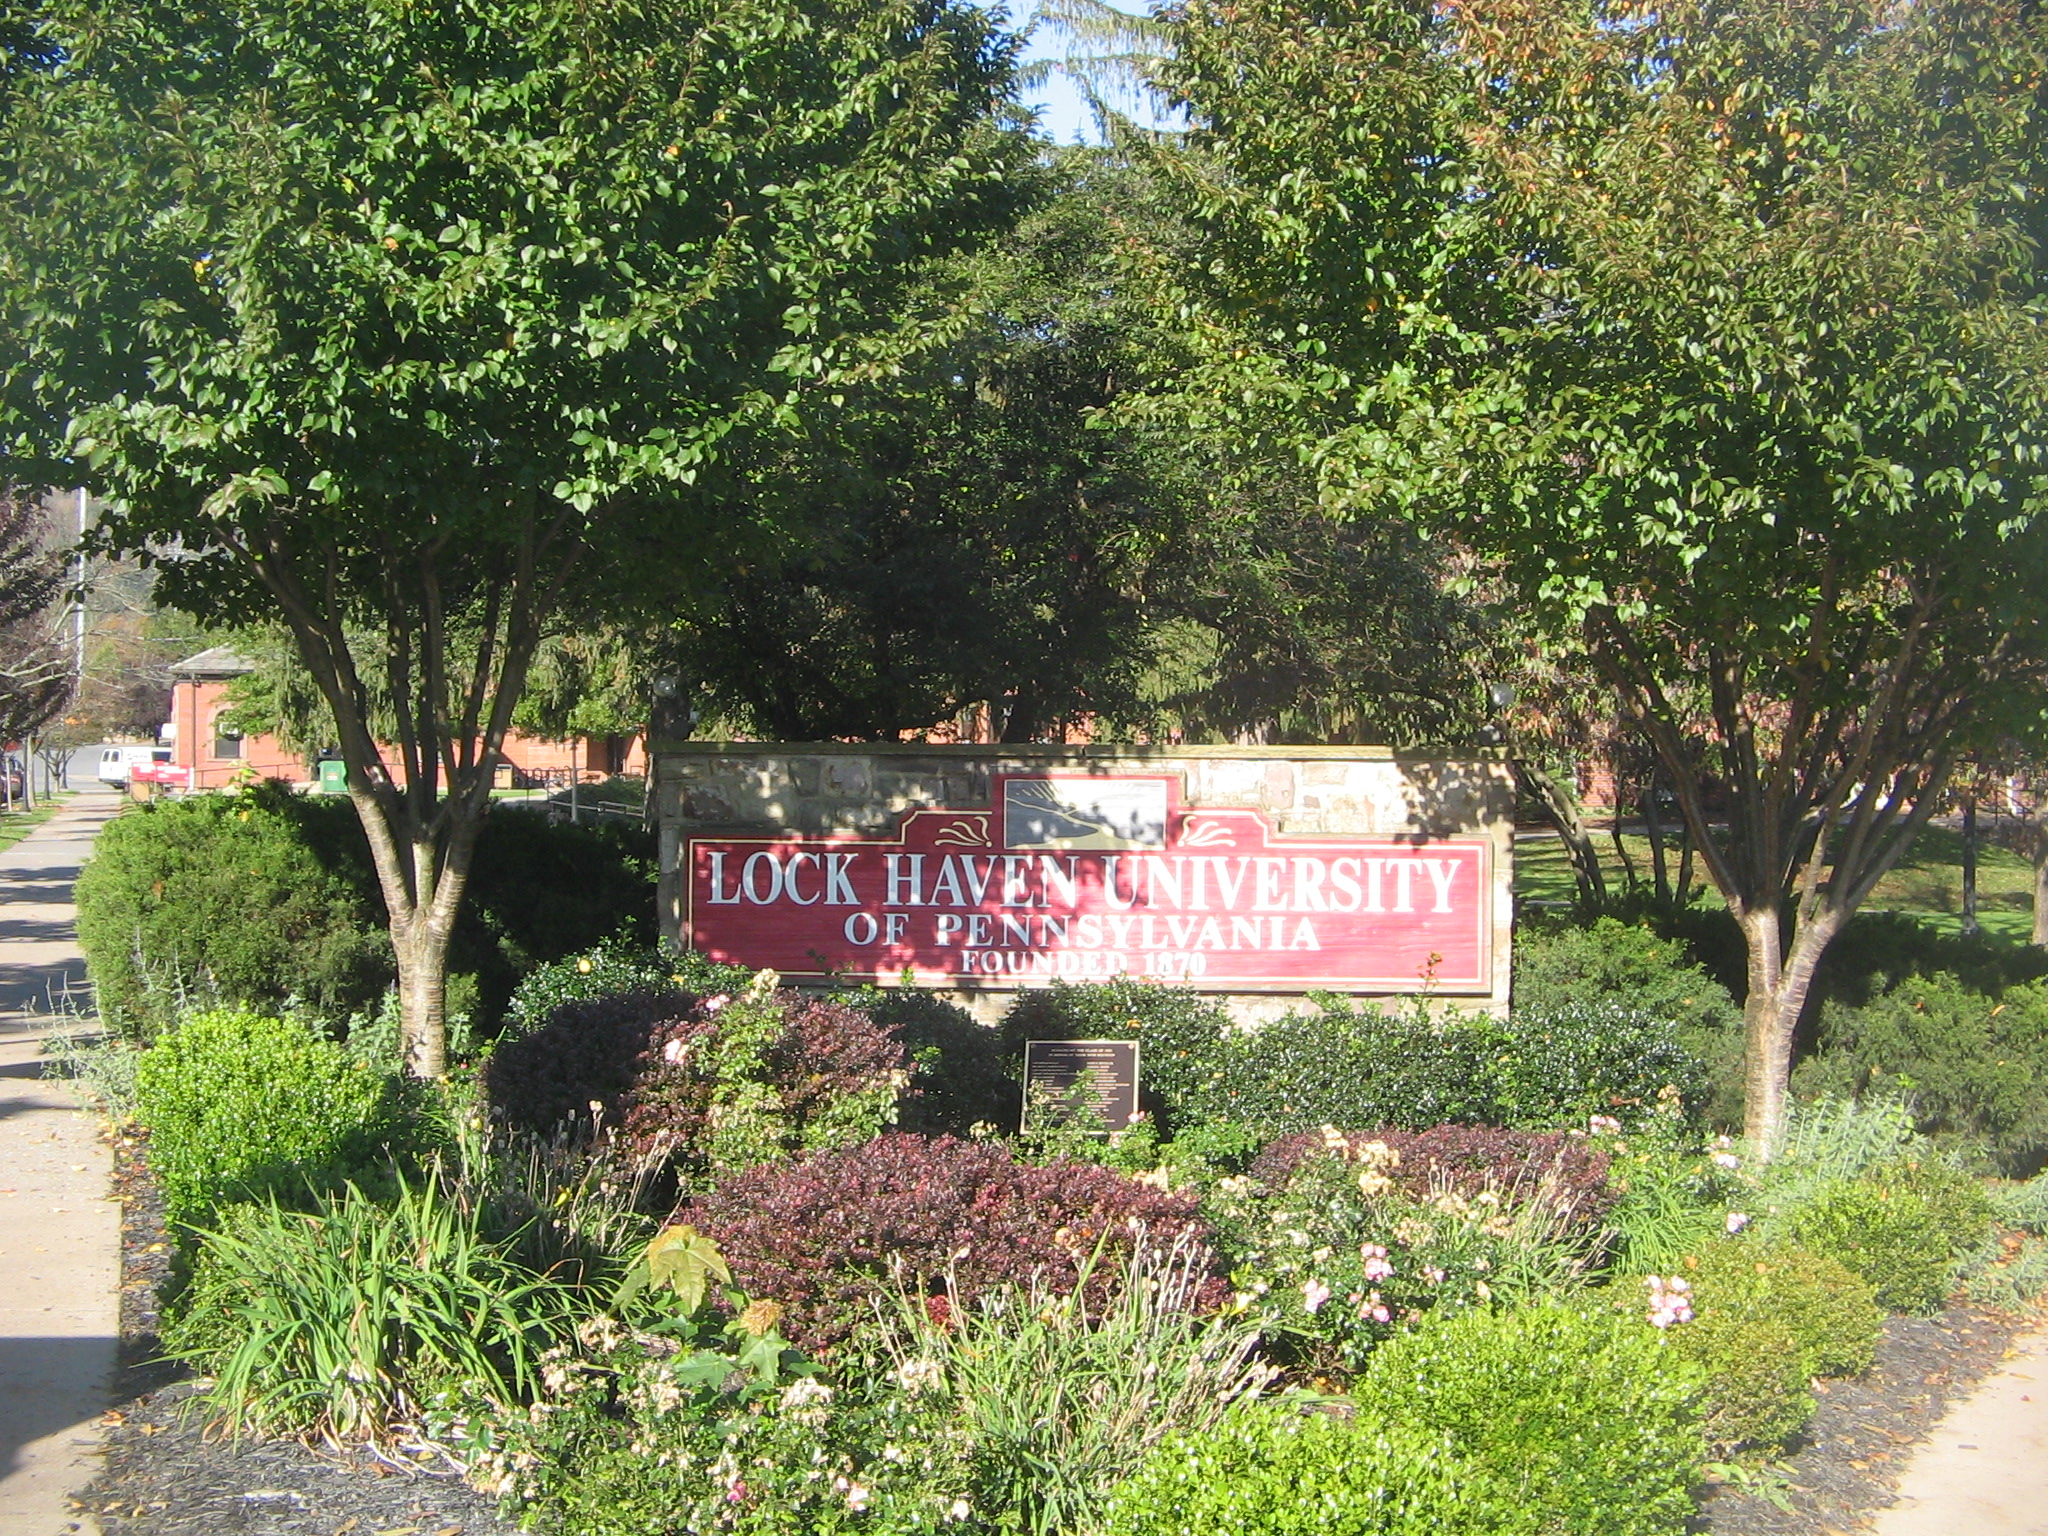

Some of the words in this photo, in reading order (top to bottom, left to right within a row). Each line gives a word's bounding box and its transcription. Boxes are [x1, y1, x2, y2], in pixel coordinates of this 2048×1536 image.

[706, 851, 862, 906] LOCK
[883, 853, 1080, 909] HAVEN
[1101, 855, 1462, 914] UNIVERSITY
[844, 911, 909, 946] OF
[934, 913, 1321, 951] PENNSYLVANIA
[960, 950, 1128, 976] FOUNDED
[1143, 951, 1208, 977] 1870
